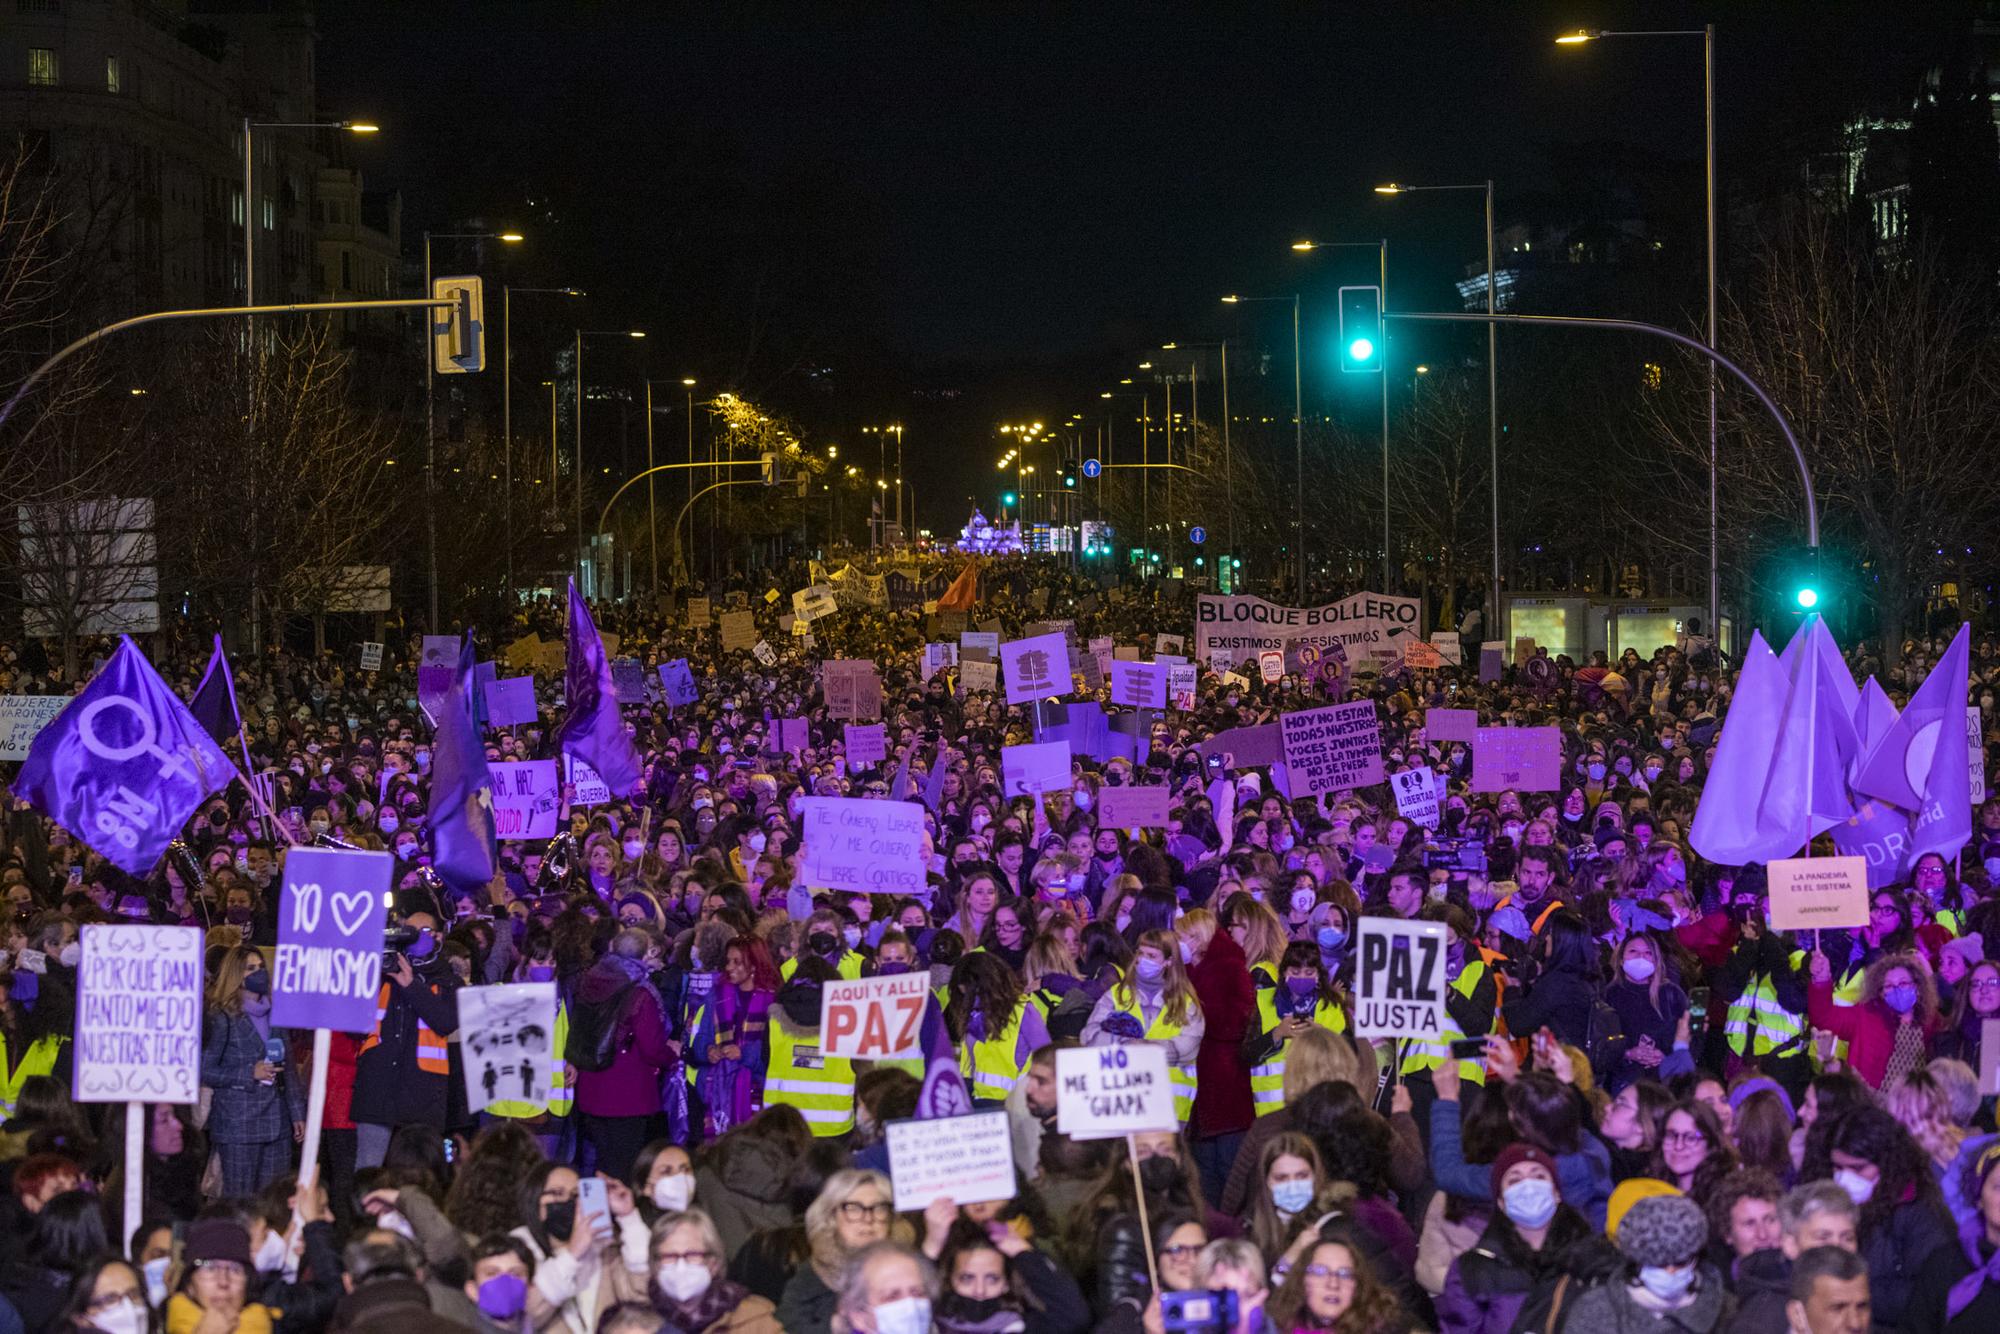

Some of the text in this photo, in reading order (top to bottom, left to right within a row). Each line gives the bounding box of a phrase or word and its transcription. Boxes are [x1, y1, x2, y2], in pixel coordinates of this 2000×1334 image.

[1199, 599, 1418, 626] BLOQUE BOLLERO
[1207, 637, 1282, 649] EXISTIMOS
[1, 696, 65, 709] MUJERES
[2, 708, 56, 719] VARONES
[1285, 705, 1374, 729] HOY NO ESTAN
[1286, 718, 1377, 744] TODAS NUESTRAS
[1286, 742, 1327, 756] VOCES
[1329, 734, 1369, 751] JUNTAS
[1291, 746, 1380, 769] DESDE LA TUMBA
[1307, 758, 1369, 777] NO SE PUEDE
[515, 769, 535, 796] HAZ
[580, 787, 609, 802] GUERRA
[815, 806, 832, 825] TE
[887, 814, 920, 834] LIBRE
[830, 833, 839, 850] Y
[848, 837, 862, 852] ME
[817, 855, 918, 892] LIBRE CONTIGO
[1793, 871, 1848, 881] LA PANDEMIA
[1804, 884, 1814, 892] EL
[1816, 882, 1852, 891] SISTEMA
[289, 882, 323, 934] YO
[161, 959, 195, 993] DAN
[272, 943, 381, 999] FEMINISMO
[1361, 933, 1440, 1002] PAZ
[874, 983, 884, 997] Y
[84, 993, 195, 1032] TANTO MIEDO
[1359, 1002, 1438, 1033] JUSTA
[825, 996, 924, 1055] PAZ
[81, 1031, 151, 1065] NUESTRAS
[1100, 1048, 1128, 1069] NO
[1065, 1071, 1153, 1093] ME LLAMO
